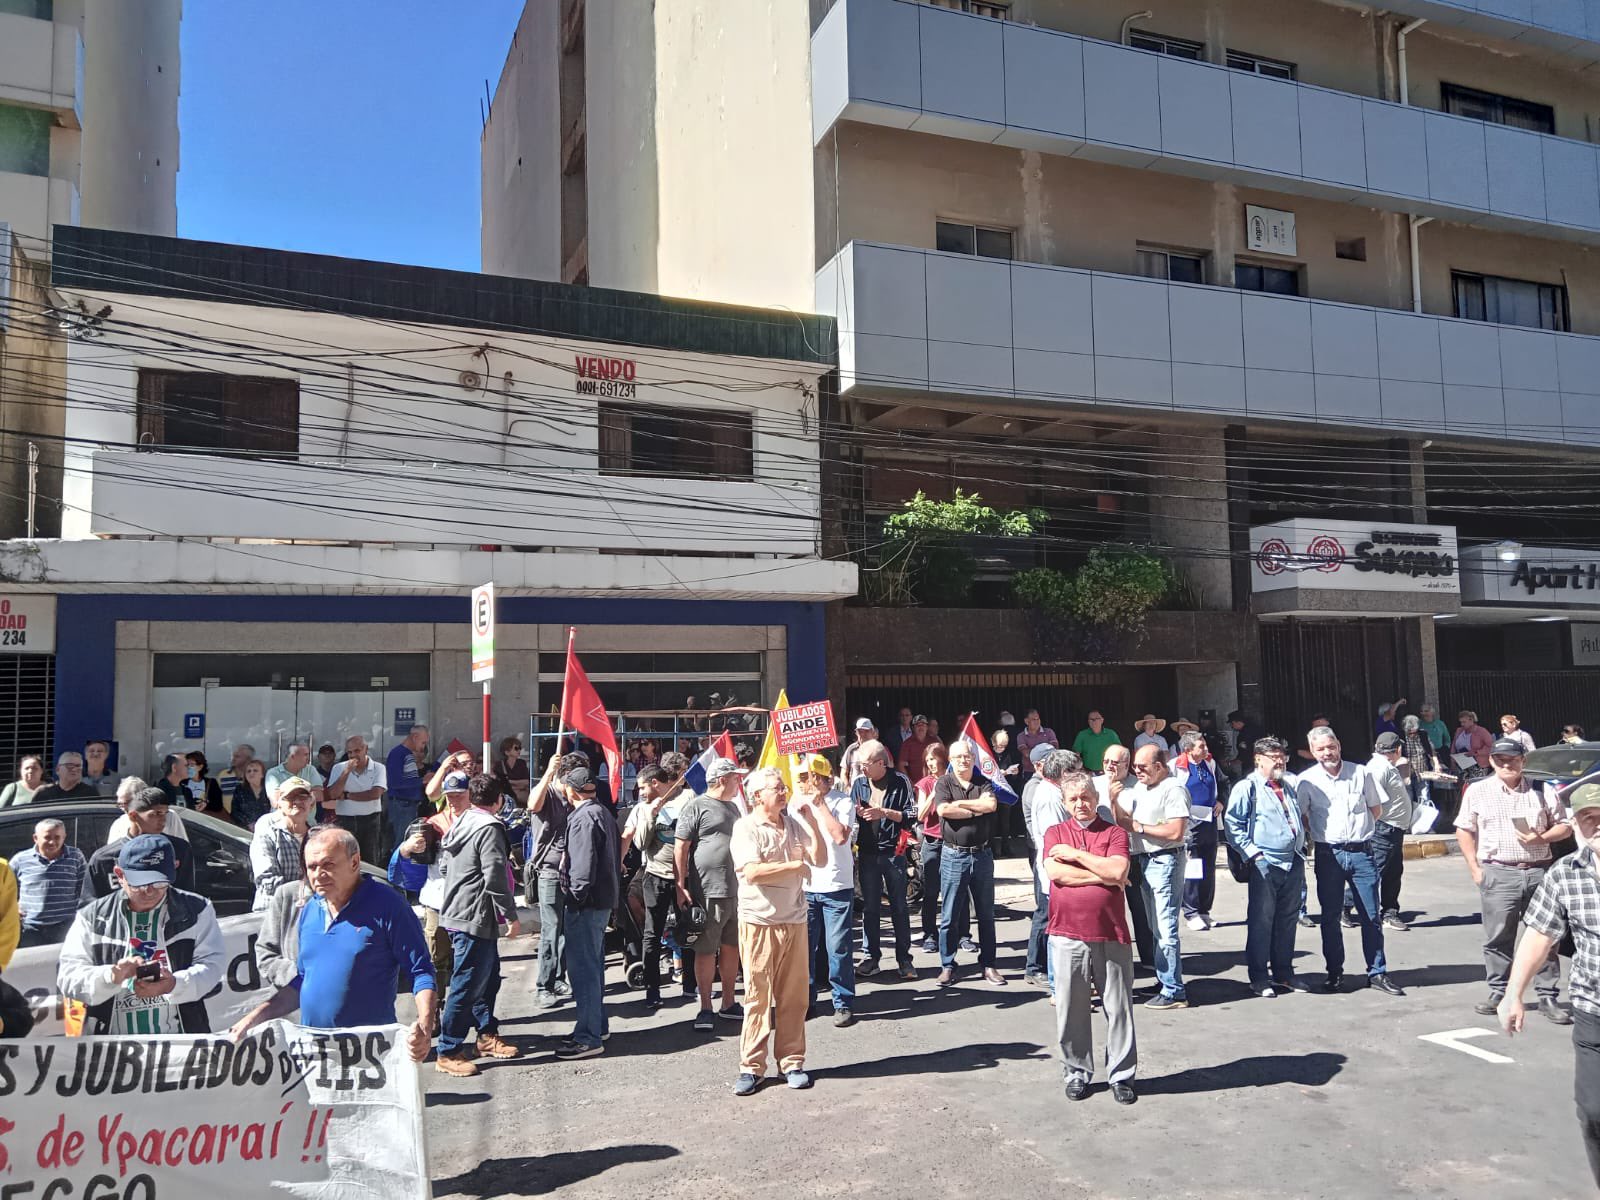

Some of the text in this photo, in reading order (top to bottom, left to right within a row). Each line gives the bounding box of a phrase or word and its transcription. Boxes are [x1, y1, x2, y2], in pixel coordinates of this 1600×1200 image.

[575, 356, 637, 382] VENDO
[1510, 560, 1584, 595] Apart
[479, 599, 487, 628] E
[776, 704, 826, 723] JUBILADOS
[782, 716, 825, 733] ANDE
[780, 738, 834, 755] PRESENTE
[781, 727, 829, 740] MOVIMIENTO
[56, 1027, 276, 1097] JUBILADOS
[312, 1031, 392, 1091] IPS
[37, 1112, 86, 1169] de
[98, 1101, 294, 1178] Ypacaraí
